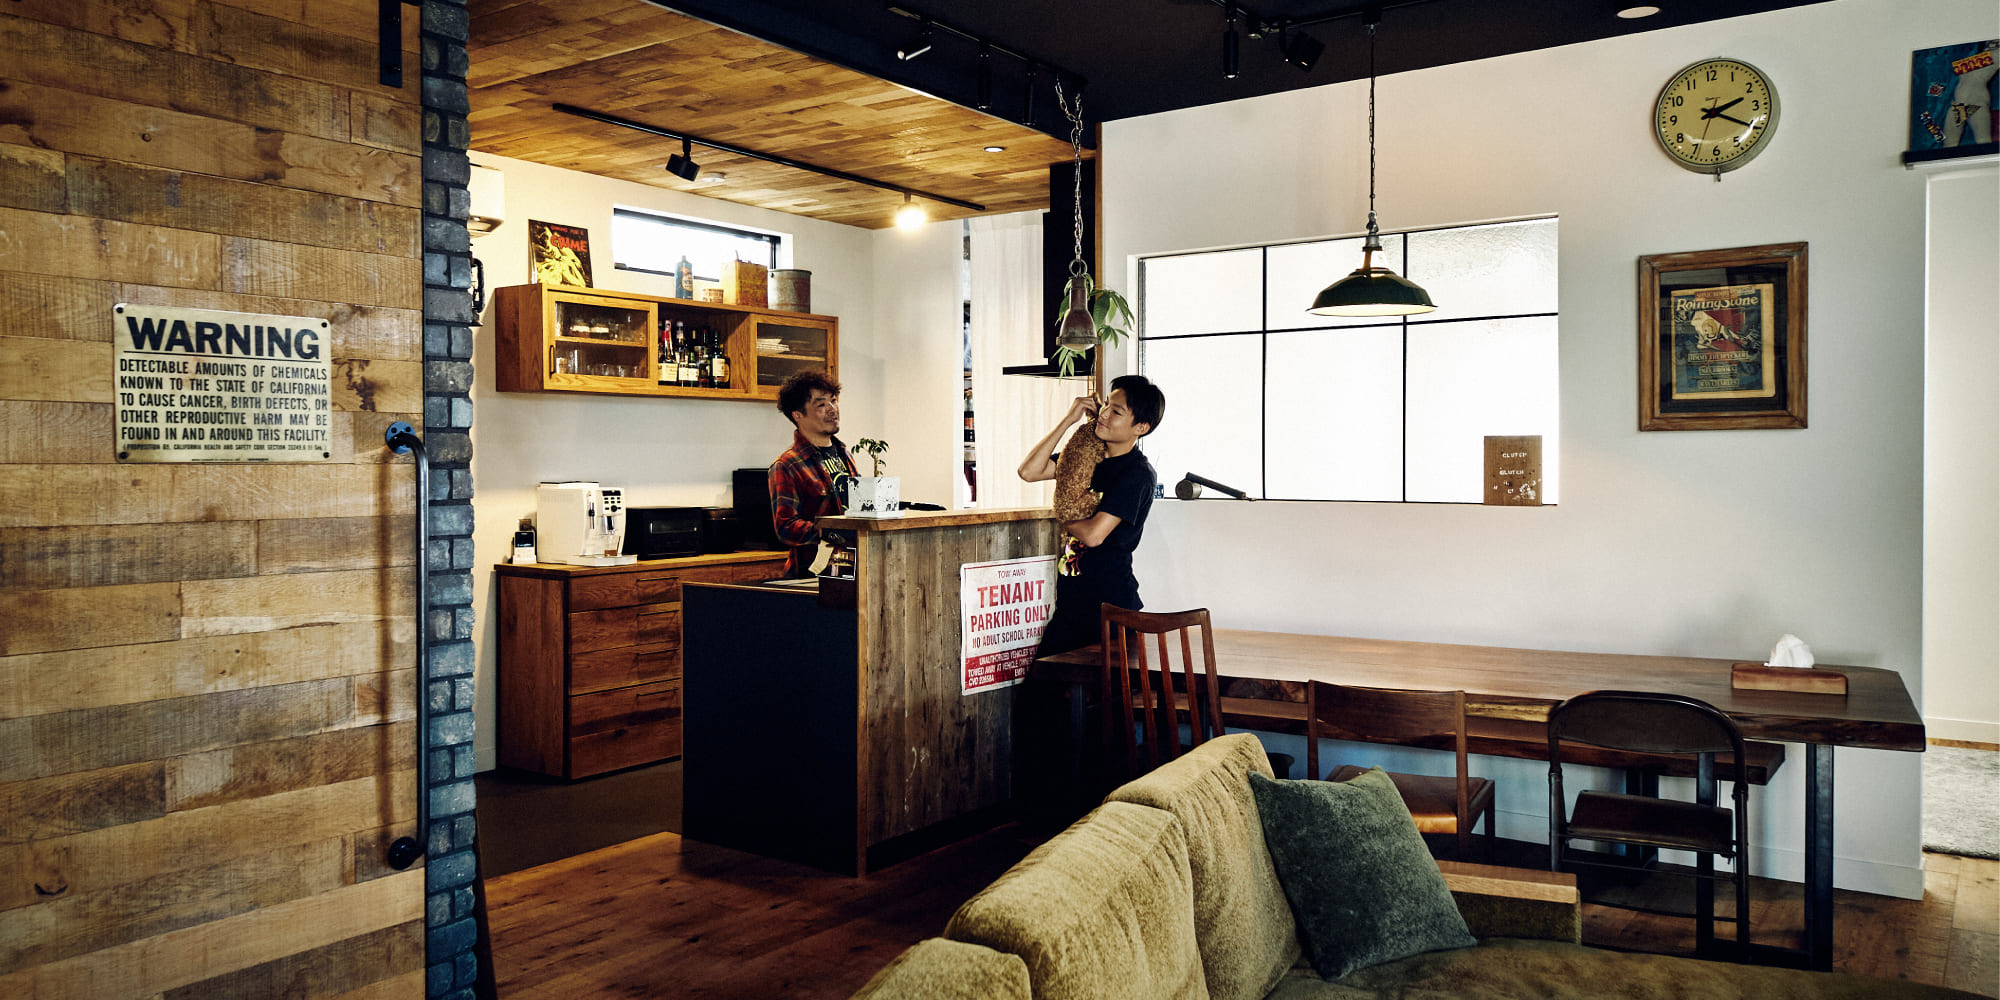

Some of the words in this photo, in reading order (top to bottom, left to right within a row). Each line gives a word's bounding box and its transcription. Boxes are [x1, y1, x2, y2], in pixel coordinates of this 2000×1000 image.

[1706, 70, 1717, 82] 12
[1687, 79, 1696, 91] 11
[1745, 82, 1753, 93] 2
[1671, 96, 1683, 107] 10
[1752, 100, 1759, 111] 3
[1670, 115, 1677, 125] 9
[1677, 133, 1684, 144] 8
[1733, 136, 1740, 147] 5
[1692, 143, 1699, 154] 7
[1713, 145, 1720, 156] 6
[551, 235, 588, 252] CRIME
[126, 316, 320, 360] WARNING
[120, 359, 189, 374] DETECTABLE
[195, 362, 246, 376] AMOUNTS
[253, 365, 265, 377] OF
[272, 366, 327, 380] CHEMICALS
[120, 376, 163, 390] KNOWN
[169, 378, 183, 390] TO
[189, 379, 210, 391] THE
[216, 380, 246, 392] STATE
[252, 381, 264, 393] OF
[270, 382, 327, 395] CALIFORNIA
[120, 393, 134, 406] TO
[139, 393, 175, 406] CAUSE
[180, 394, 227, 410] CANCER,
[232, 396, 261, 408] BIRTH
[266, 398, 310, 411] DEFECTS,
[315, 399, 328, 410] OR
[121, 410, 158, 423] OTHER
[166, 411, 246, 425] REPRODUCTIVE
[254, 412, 282, 425] HARM
[290, 414, 309, 426] MAY
[316, 414, 327, 426] BE
[122, 427, 160, 440] FOUND
[165, 427, 177, 440] IN
[182, 428, 205, 440] AND
[210, 428, 253, 441] AROUND
[257, 429, 280, 441] THIS
[284, 429, 328, 441] FACILITY.
[998, 570, 1010, 578] TOW
[1012, 568, 1026, 577] AWAY
[977, 580, 1044, 608] TENANT
[970, 608, 1020, 632] PARKING
[1025, 604, 1050, 623] ONLY
[972, 637, 980, 648] NO
[983, 634, 1000, 647] ADULT
[1002, 630, 1024, 644] SCHOOL
[1010, 648, 1028, 660] VEHICLES
[968, 667, 984, 678] TOWED
